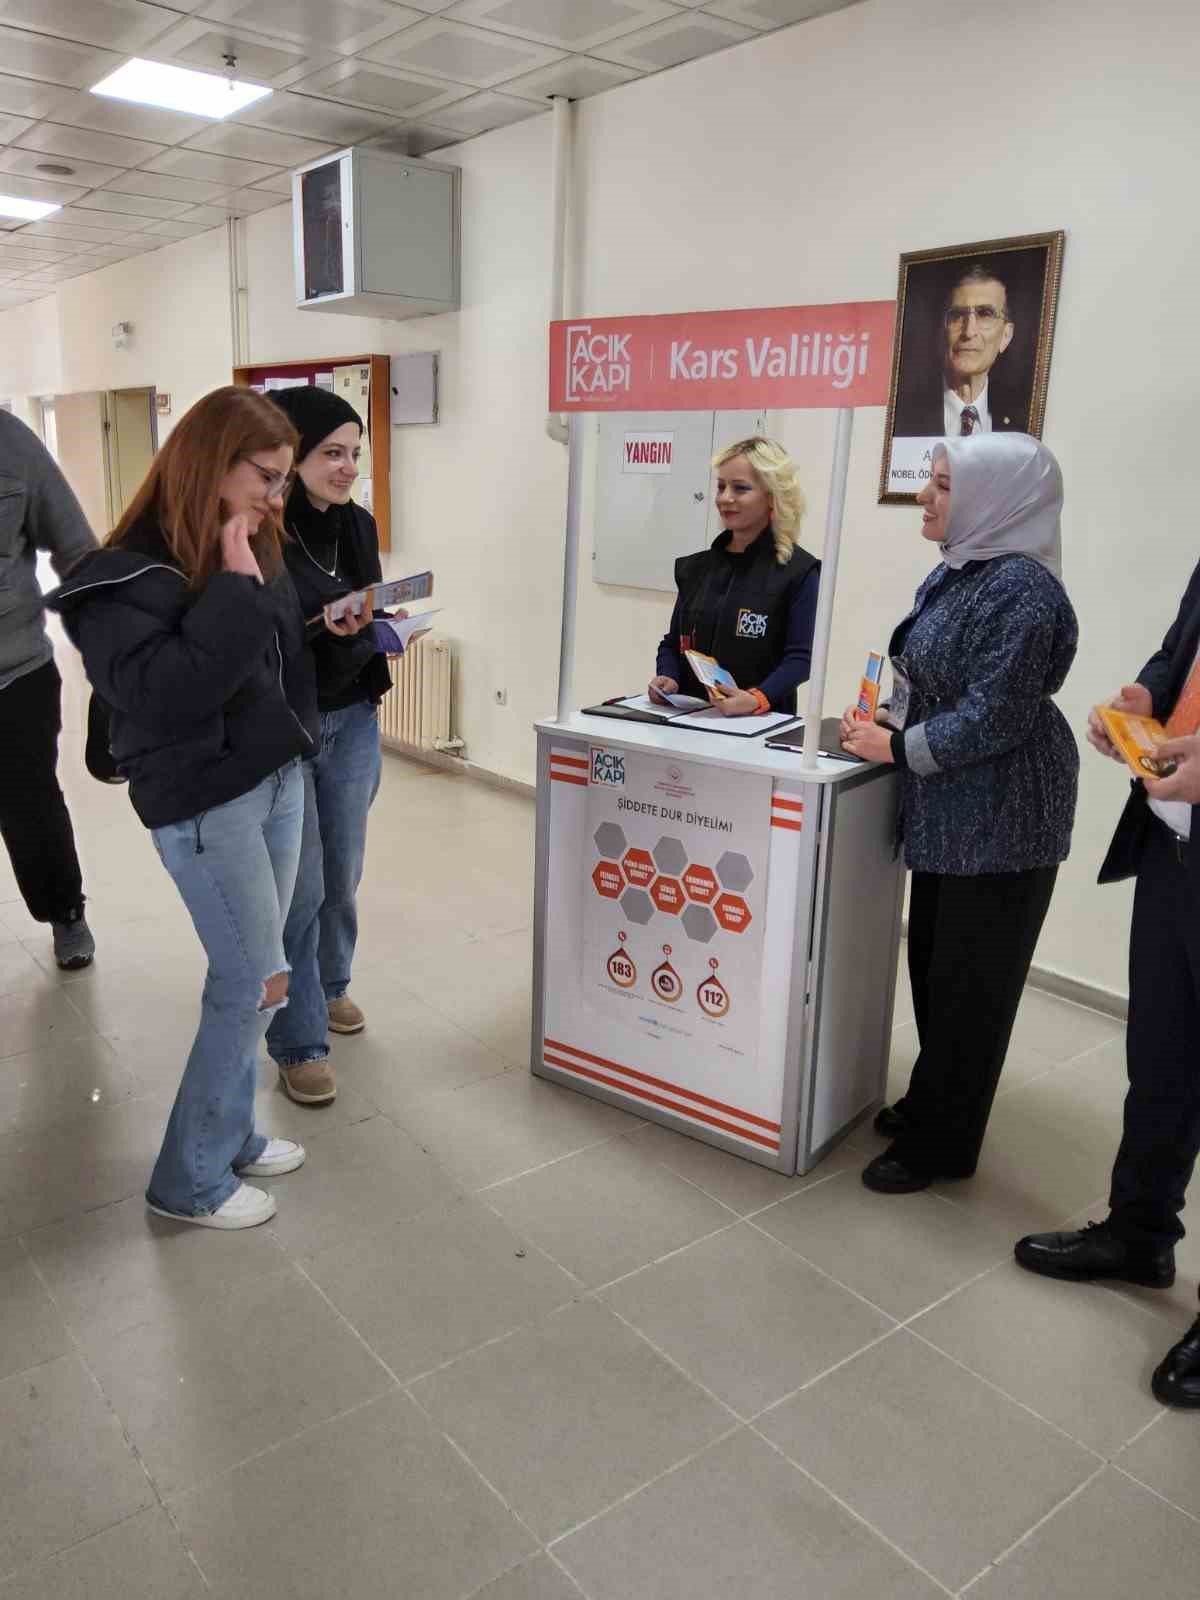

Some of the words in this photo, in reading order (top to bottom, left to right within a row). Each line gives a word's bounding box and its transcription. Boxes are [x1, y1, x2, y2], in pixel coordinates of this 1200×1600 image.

[670, 340, 739, 380] Kars
[745, 332, 870, 389] Valiliği
[571, 364, 631, 393] KAPI
[626, 442, 672, 464] YANGIN
[594, 767, 625, 784] KAPI
[660, 807, 682, 822] DUR
[612, 961, 632, 978] 183
[704, 990, 723, 1007] 112
